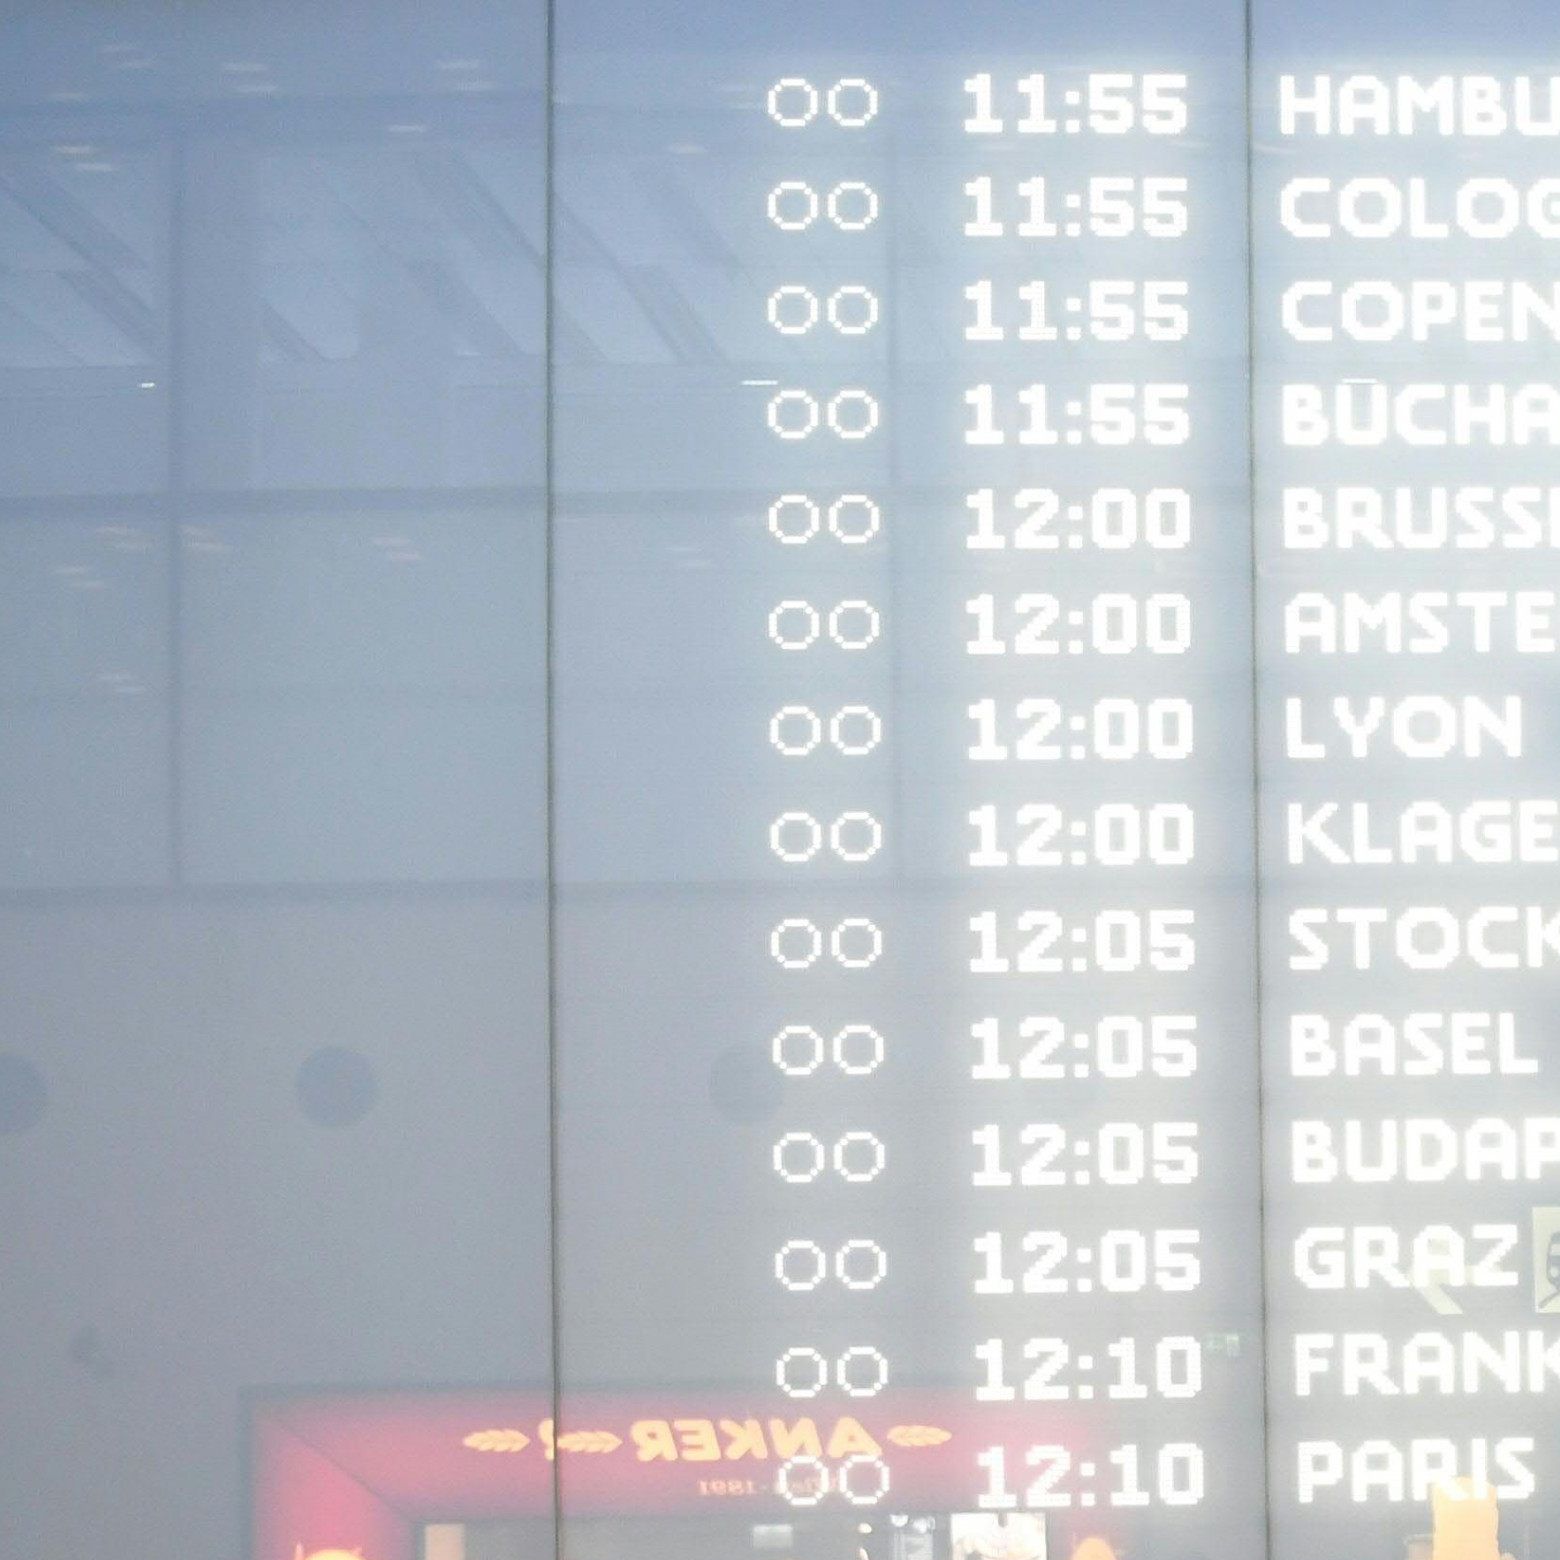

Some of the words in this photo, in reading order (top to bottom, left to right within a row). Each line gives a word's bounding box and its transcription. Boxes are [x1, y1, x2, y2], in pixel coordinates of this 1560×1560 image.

[966, 74, 1186, 133] 11:55
[966, 177, 1186, 236] 11:55
[966, 281, 1188, 340] 11:55
[966, 384, 1189, 444] 11:55
[967, 489, 1190, 548] 12:00
[967, 594, 1190, 654] 12:00
[969, 699, 1192, 760] 12:00
[1287, 696, 1521, 758] LYON
[970, 804, 1193, 866] 12:00
[970, 910, 1194, 972] 12:05
[972, 1016, 1196, 1078] 12:05
[1291, 1013, 1538, 1076] BASEL
[973, 1123, 1197, 1185] 12:05
[975, 1230, 1200, 1293] 12:05
[1295, 1225, 1518, 1288] GRAZ
[976, 1337, 1201, 1400] 12:10
[977, 1444, 1203, 1508] 12:10
[1299, 1438, 1534, 1502] PARIS
